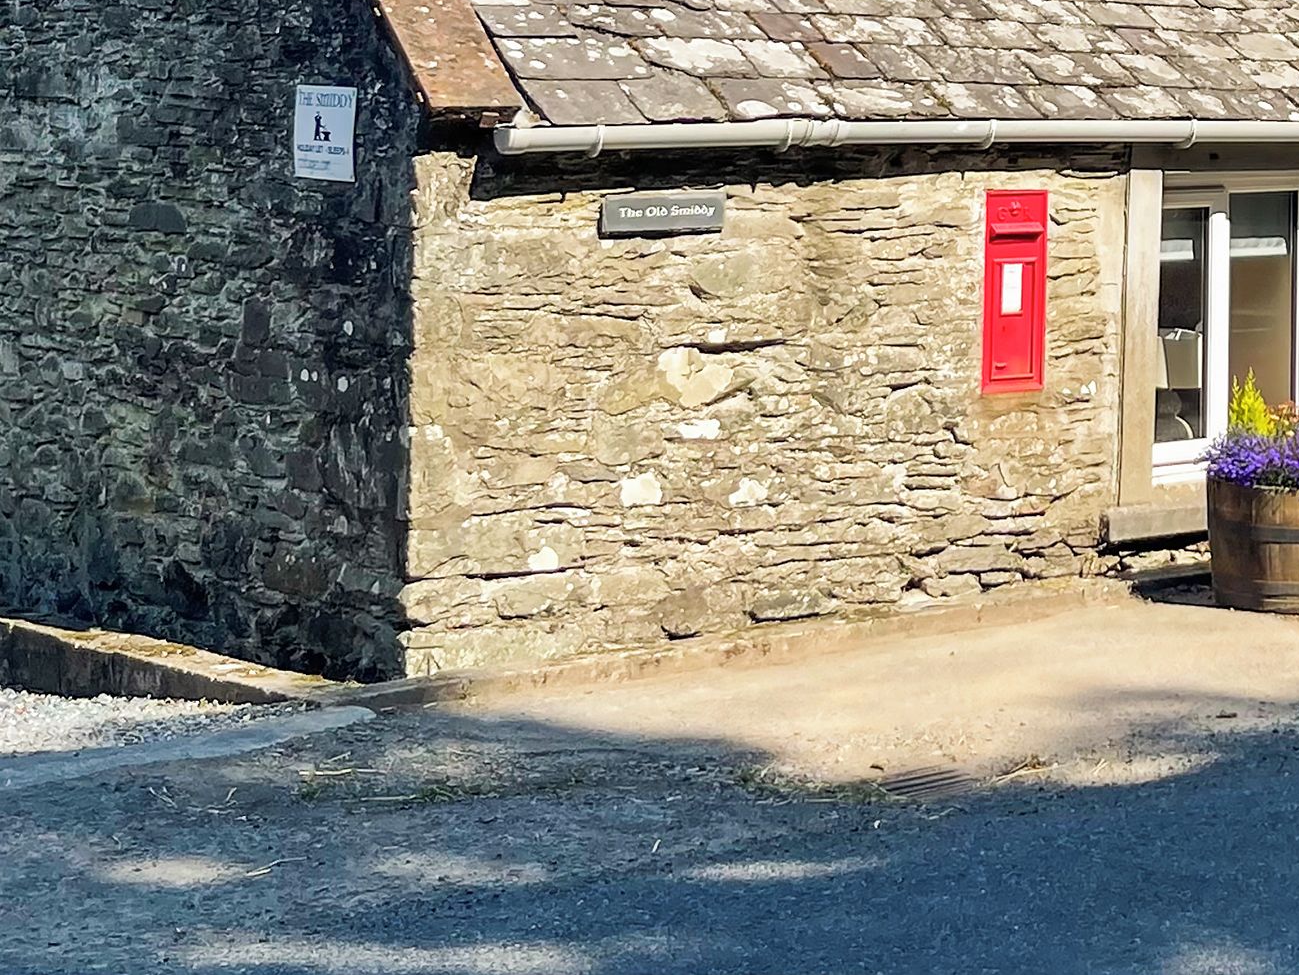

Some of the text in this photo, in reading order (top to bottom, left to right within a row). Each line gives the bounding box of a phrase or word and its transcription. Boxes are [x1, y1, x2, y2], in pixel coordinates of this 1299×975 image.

[298, 90, 314, 106] THE
[619, 204, 716, 218] The Old Smiddy
